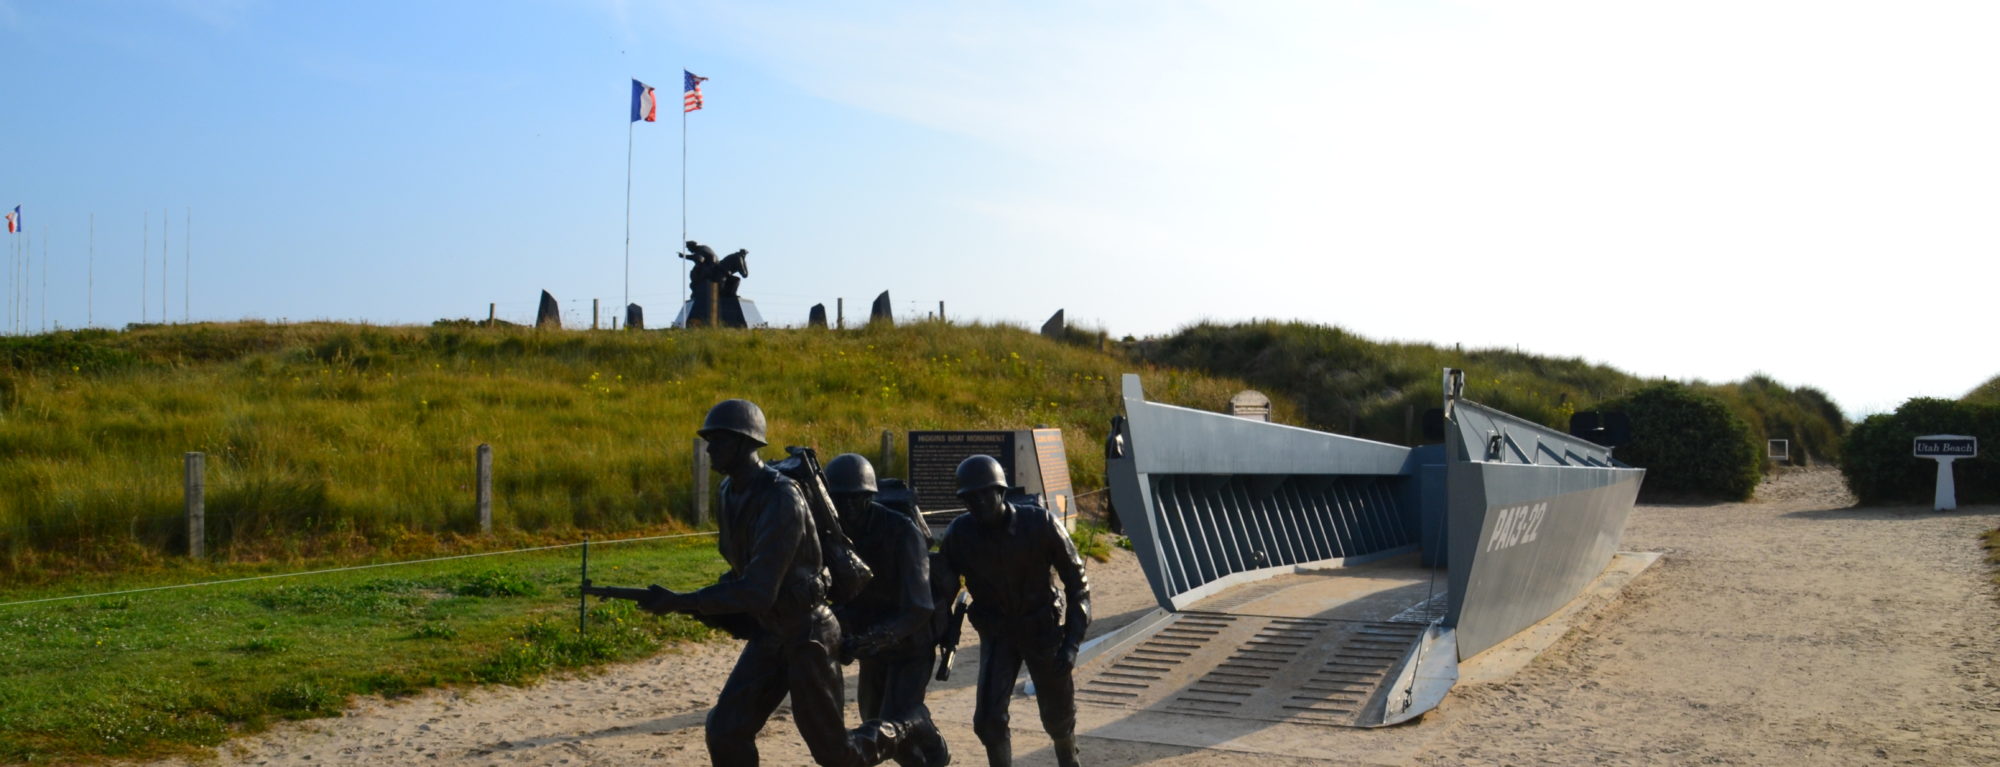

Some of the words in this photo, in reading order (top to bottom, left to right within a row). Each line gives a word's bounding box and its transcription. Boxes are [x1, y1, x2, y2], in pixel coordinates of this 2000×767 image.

[918, 434, 946, 442] HIGGINS
[947, 434, 965, 442] BOAT
[966, 434, 1005, 442] MONUMENT
[1917, 442, 1940, 452] Utah
[1942, 442, 1973, 452] Beach
